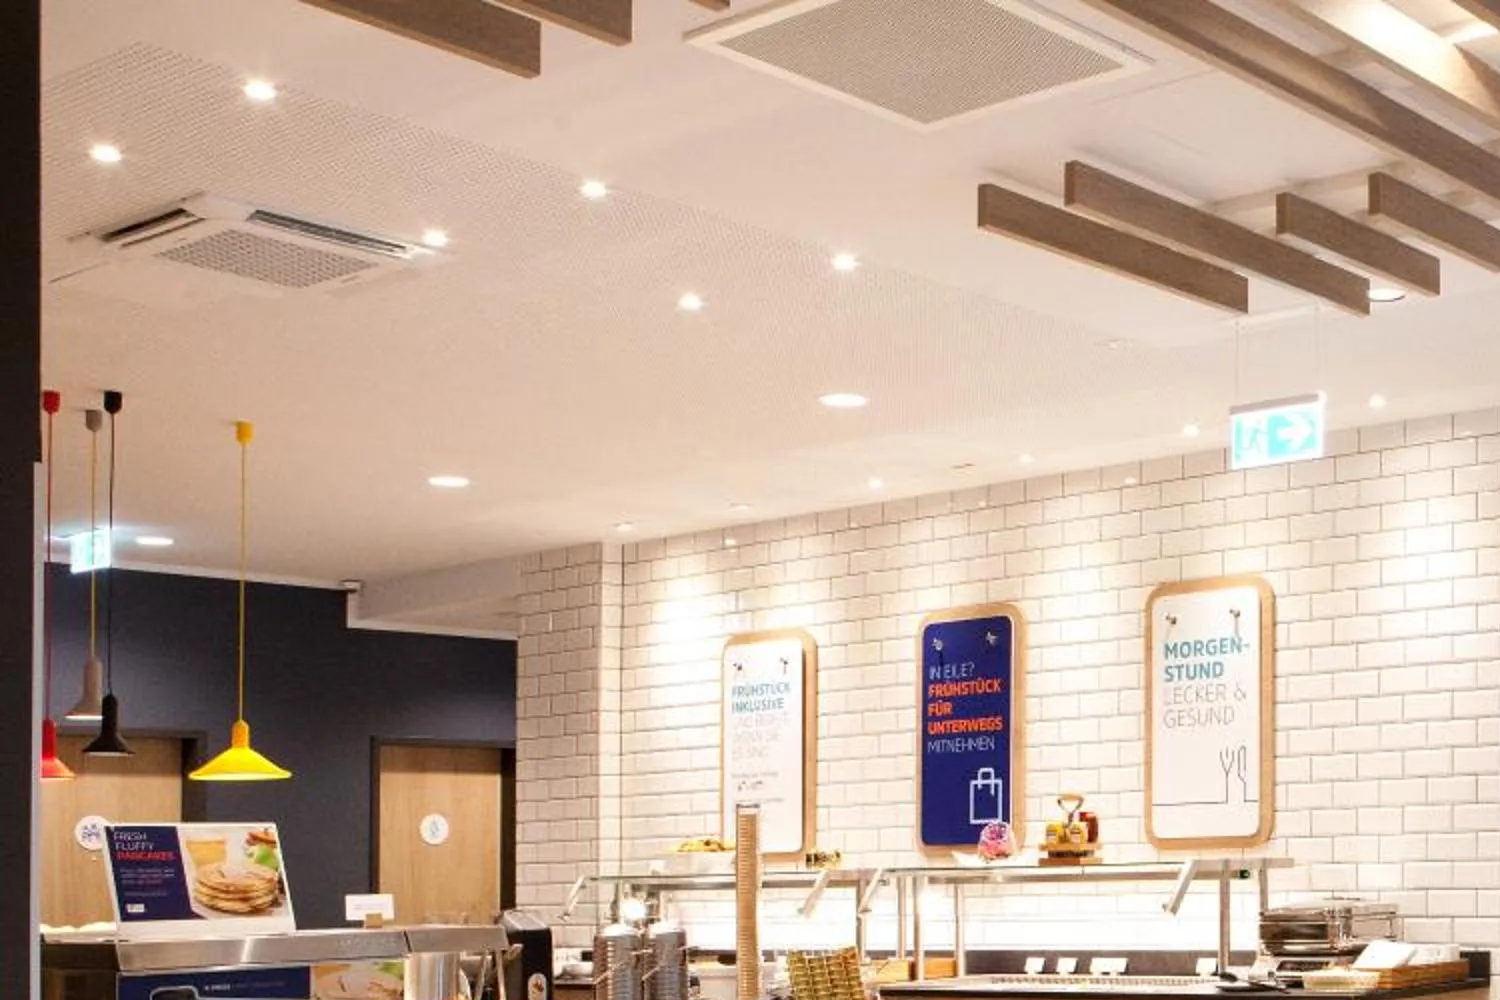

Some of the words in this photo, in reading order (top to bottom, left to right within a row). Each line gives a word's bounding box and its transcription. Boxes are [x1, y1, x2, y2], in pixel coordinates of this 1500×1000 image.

[1164, 636, 1250, 660] MORGEN-
[1164, 661, 1225, 683] STUND
[928, 676, 1002, 698] FRÜHSTÜCK
[1163, 682, 1227, 706] LECKER
[927, 699, 953, 717] FÜR
[1163, 705, 1236, 729] GESUND
[927, 715, 1003, 735] UNTERWEGS
[927, 735, 996, 753] MITNEHMEN
[113, 831, 148, 841] FRESH
[115, 841, 154, 852] FLUFFY
